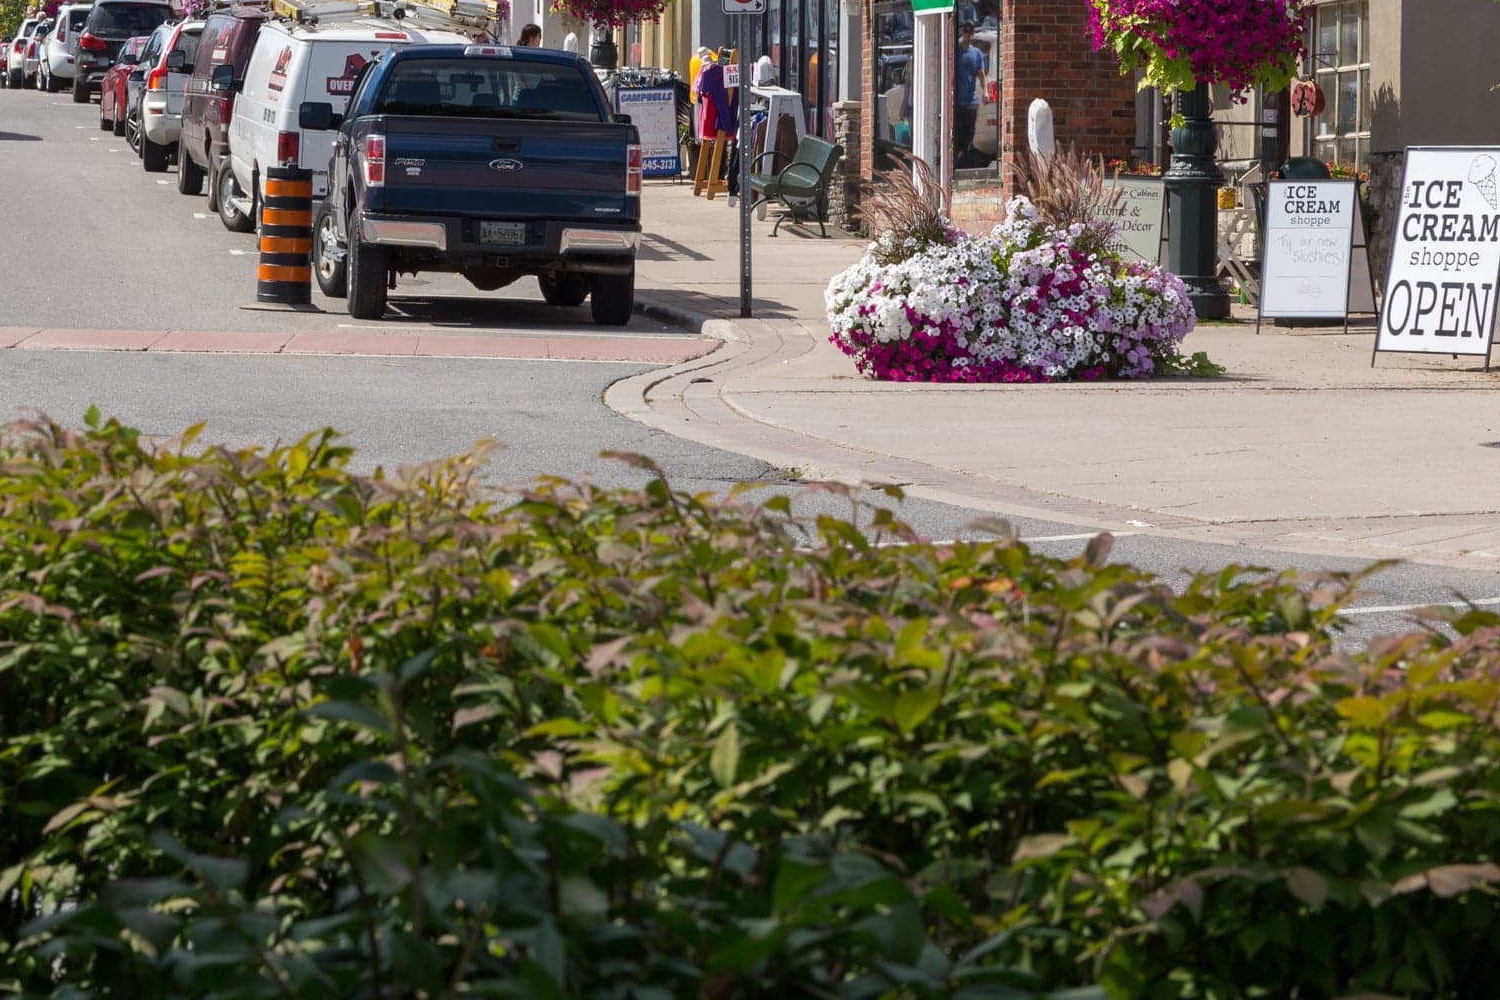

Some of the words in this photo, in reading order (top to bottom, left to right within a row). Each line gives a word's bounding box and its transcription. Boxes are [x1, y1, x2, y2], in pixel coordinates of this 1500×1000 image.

[620, 91, 673, 103] CAMPBELLS
[1129, 188, 1159, 200] Cabinet
[1286, 185, 1317, 200] ICE
[1408, 180, 1463, 209] ICE
[1130, 206, 1142, 217] &
[1284, 200, 1341, 214] CREAM
[1290, 215, 1331, 227] shoppe
[1402, 213, 1500, 242] CREAM
[1106, 240, 1129, 253] ifts
[1409, 246, 1480, 272] shoppe
[1386, 279, 1493, 339] OPEN
